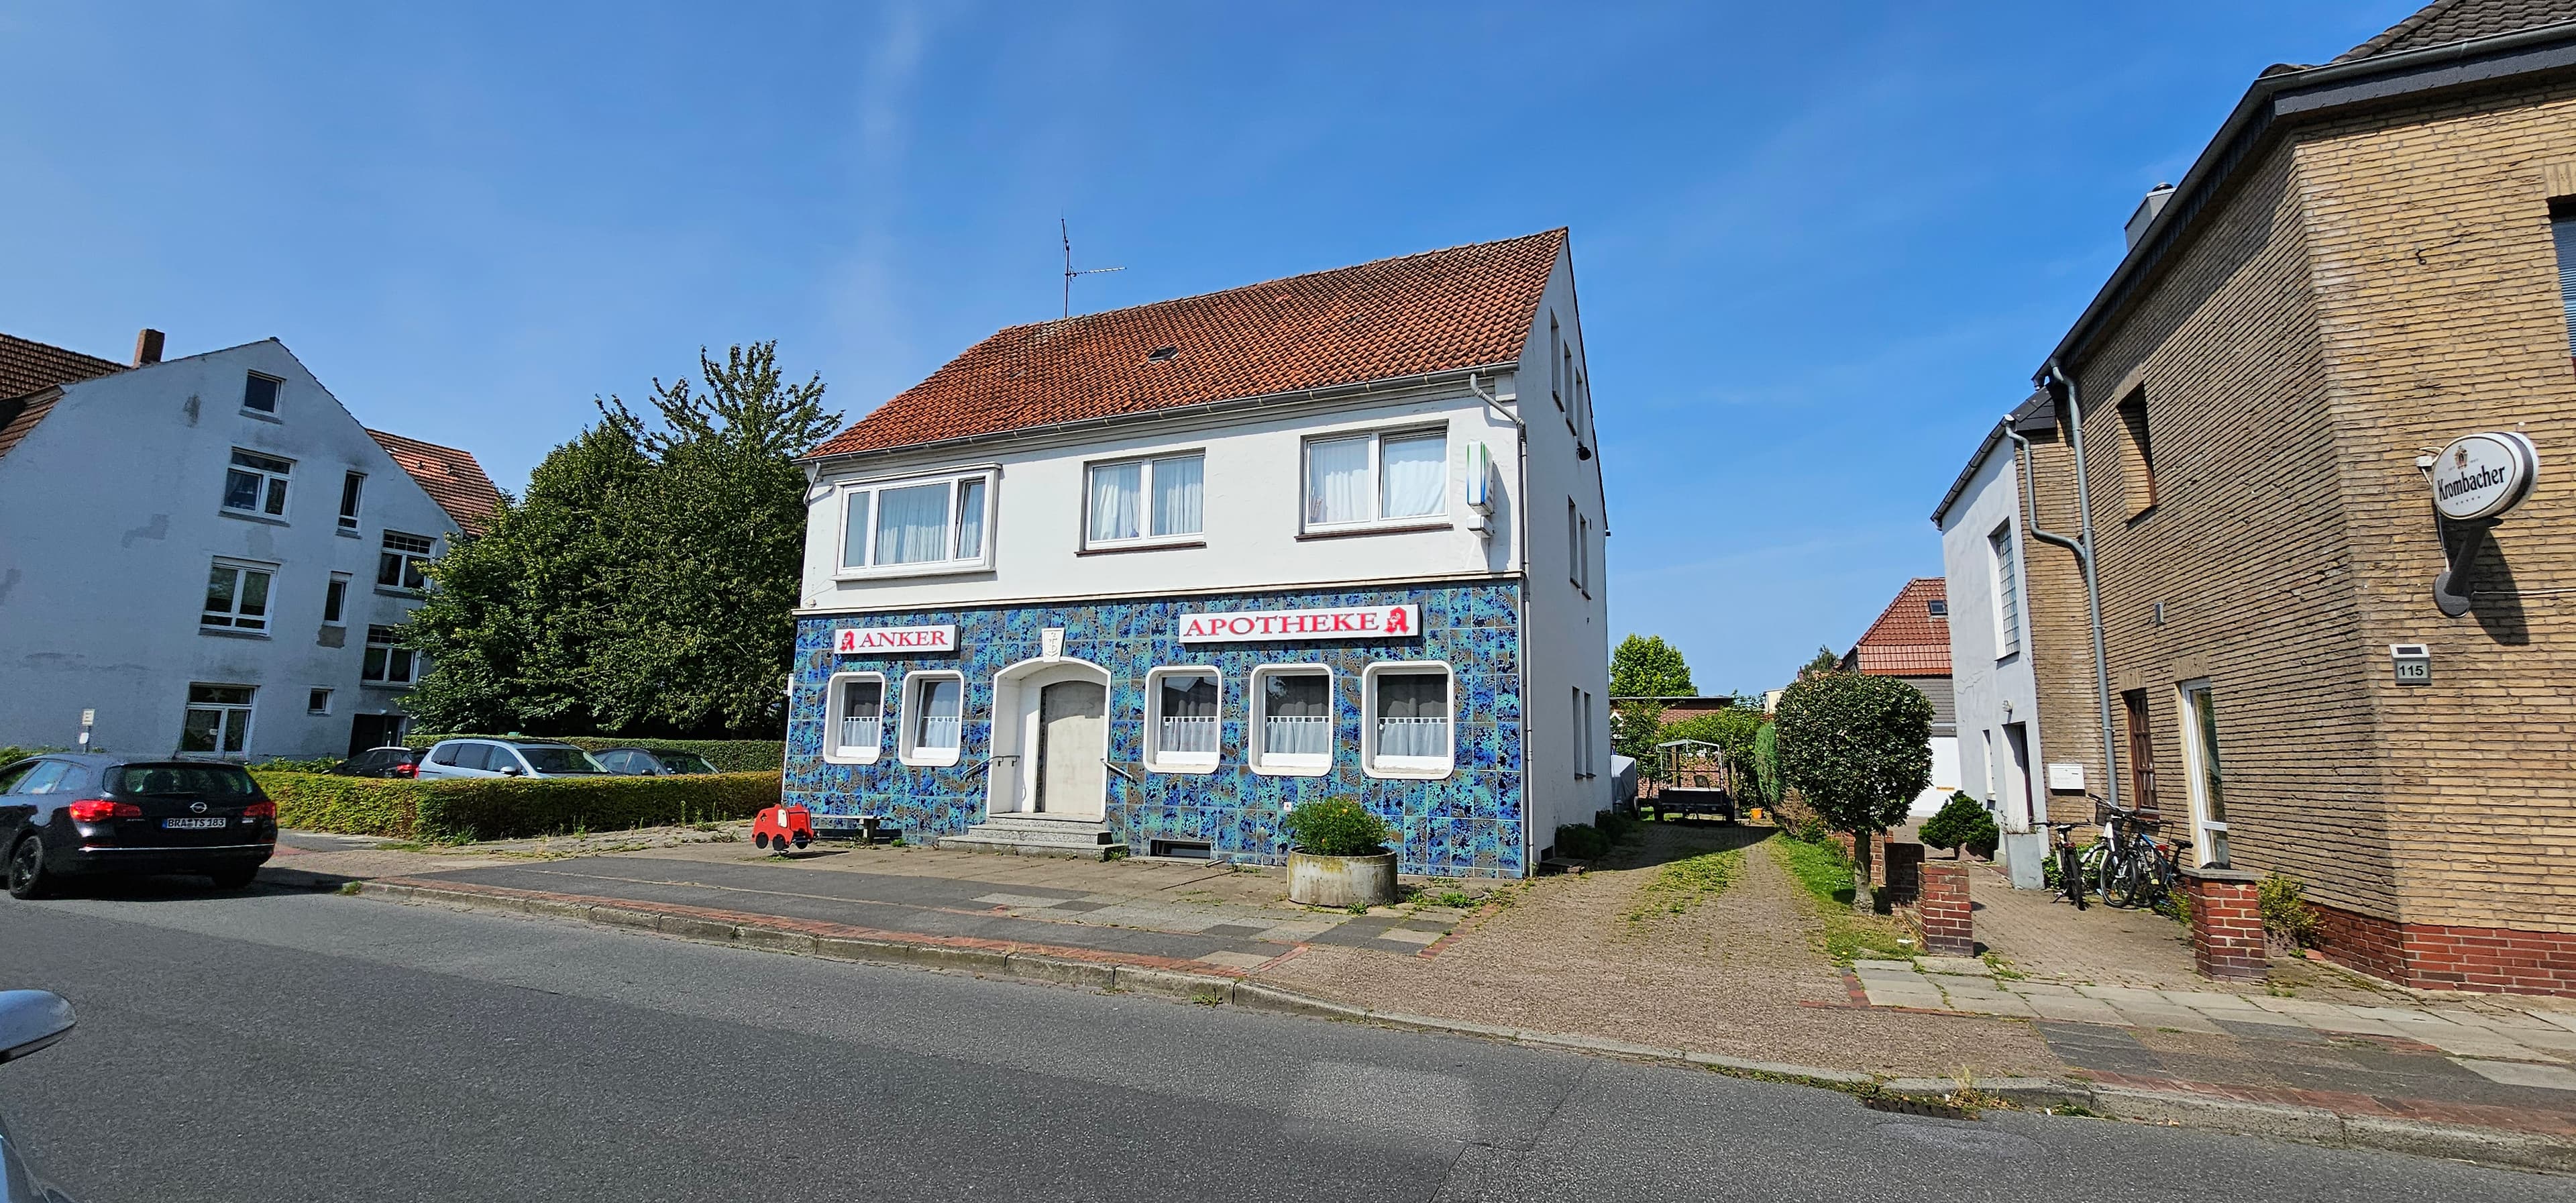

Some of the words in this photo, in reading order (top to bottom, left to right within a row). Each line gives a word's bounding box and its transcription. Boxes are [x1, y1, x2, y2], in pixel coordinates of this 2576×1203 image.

[2437, 464, 2506, 501] Krombacher
[1183, 613, 1380, 637] APOTHEKE
[859, 631, 948, 648] ANKER
[2399, 665, 2424, 676] 115
